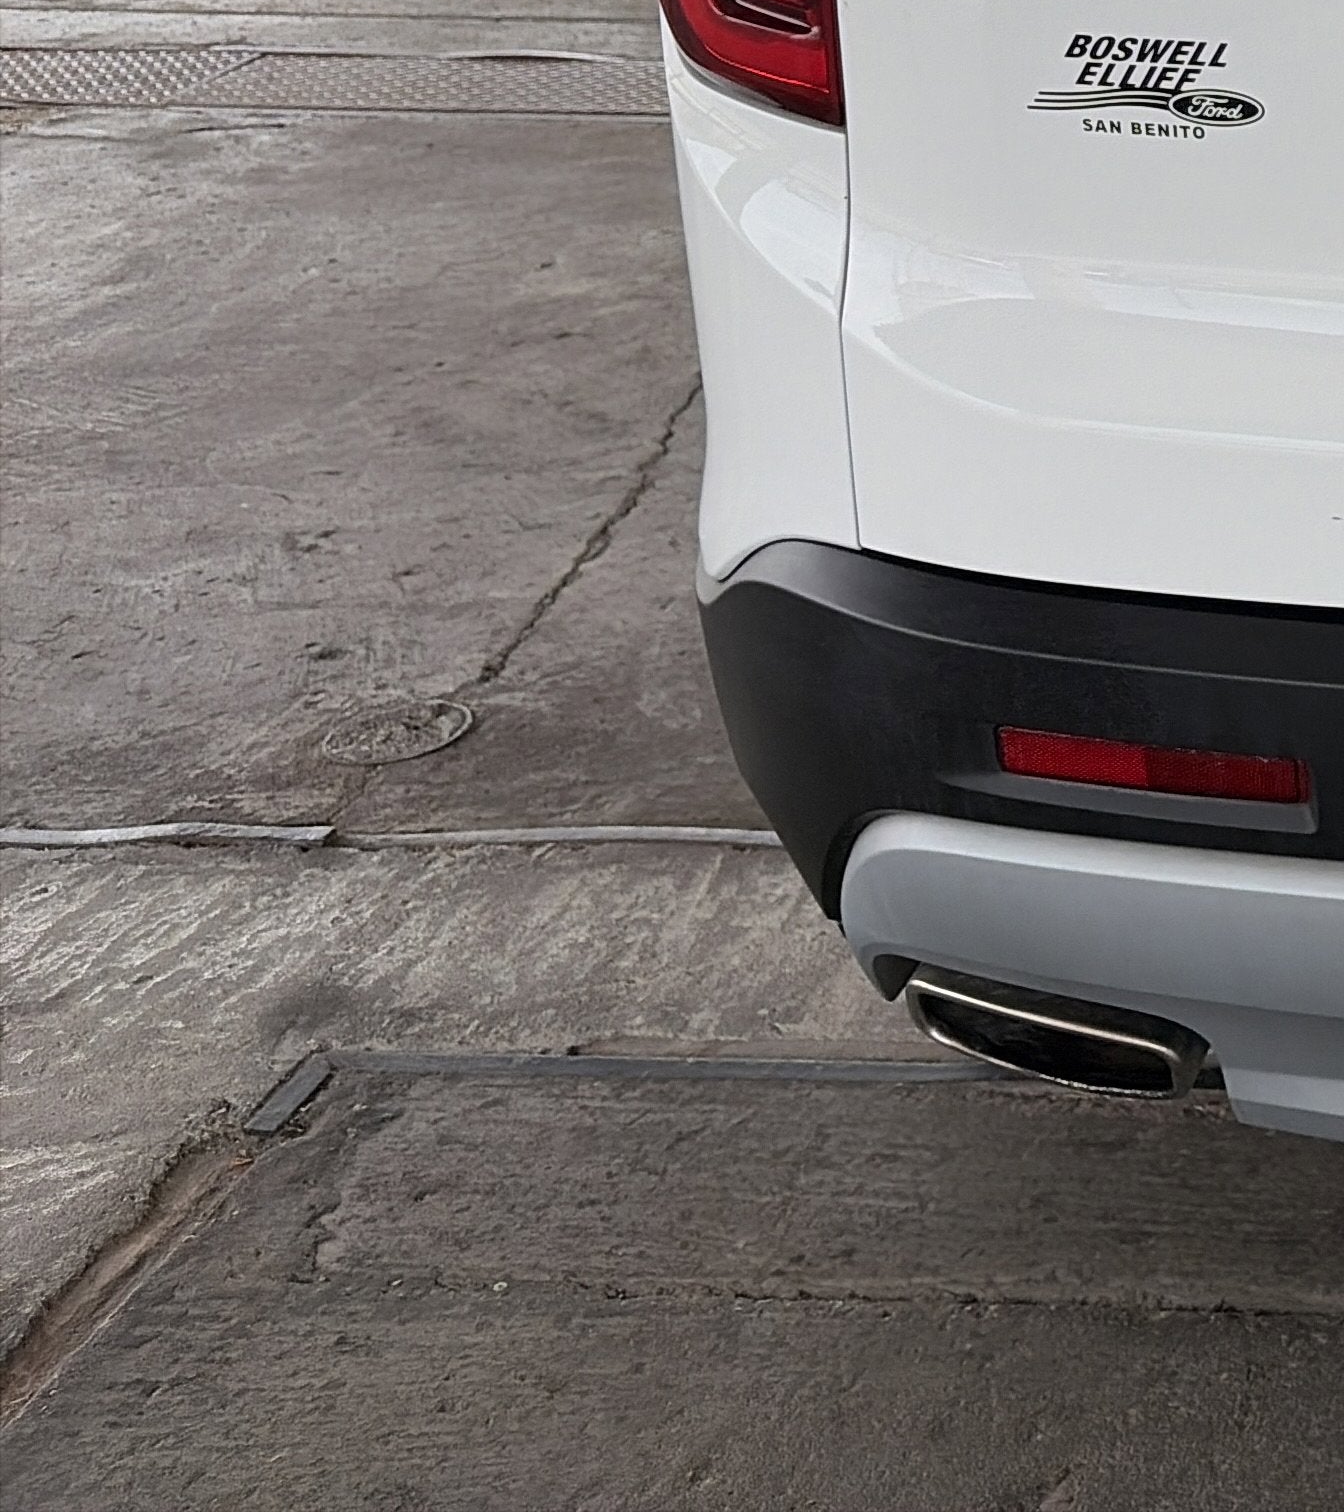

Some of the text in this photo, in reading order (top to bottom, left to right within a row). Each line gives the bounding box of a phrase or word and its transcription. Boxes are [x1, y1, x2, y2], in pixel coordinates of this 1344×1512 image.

[1063, 33, 1229, 68] BOSWELL
[1075, 61, 1202, 90] ELLIFF
[1187, 95, 1243, 120] Ford
[1082, 118, 1206, 139] SAN BENITO
